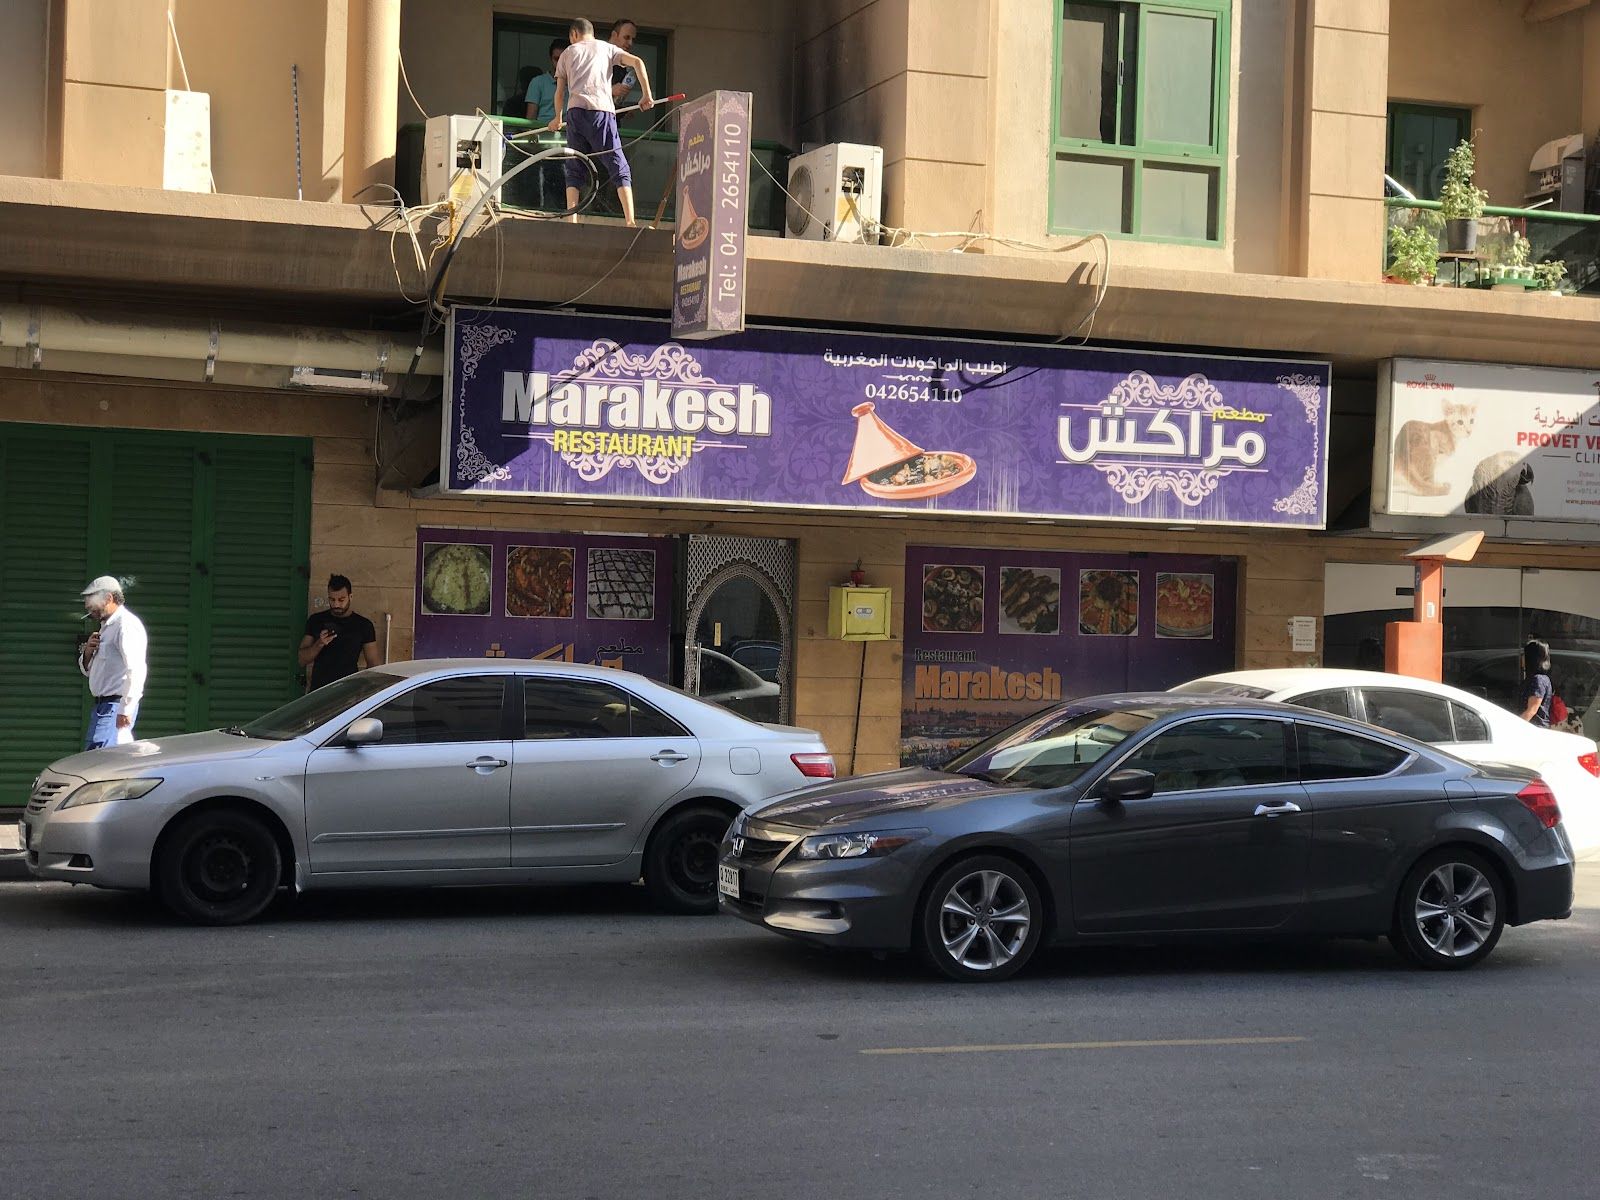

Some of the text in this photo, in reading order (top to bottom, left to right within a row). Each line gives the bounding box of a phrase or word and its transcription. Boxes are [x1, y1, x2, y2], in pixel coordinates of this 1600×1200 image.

[681, 151, 710, 182] مراكش
[721, 123, 742, 209] 2654110
[720, 231, 738, 256] 04
[719, 265, 737, 302] Tel:
[823, 348, 888, 367] المغربية
[501, 370, 771, 437] Marakesh
[865, 383, 963, 403] 042654110
[1212, 407, 1266, 423] مطعم
[1534, 406, 1583, 430] البيطرية
[553, 429, 697, 459] RESTAURANT
[1057, 394, 1267, 470] مراكش
[1516, 431, 1580, 449] PROVET
[914, 648, 977, 663] Restaurant
[914, 664, 1063, 701] Marakesh
